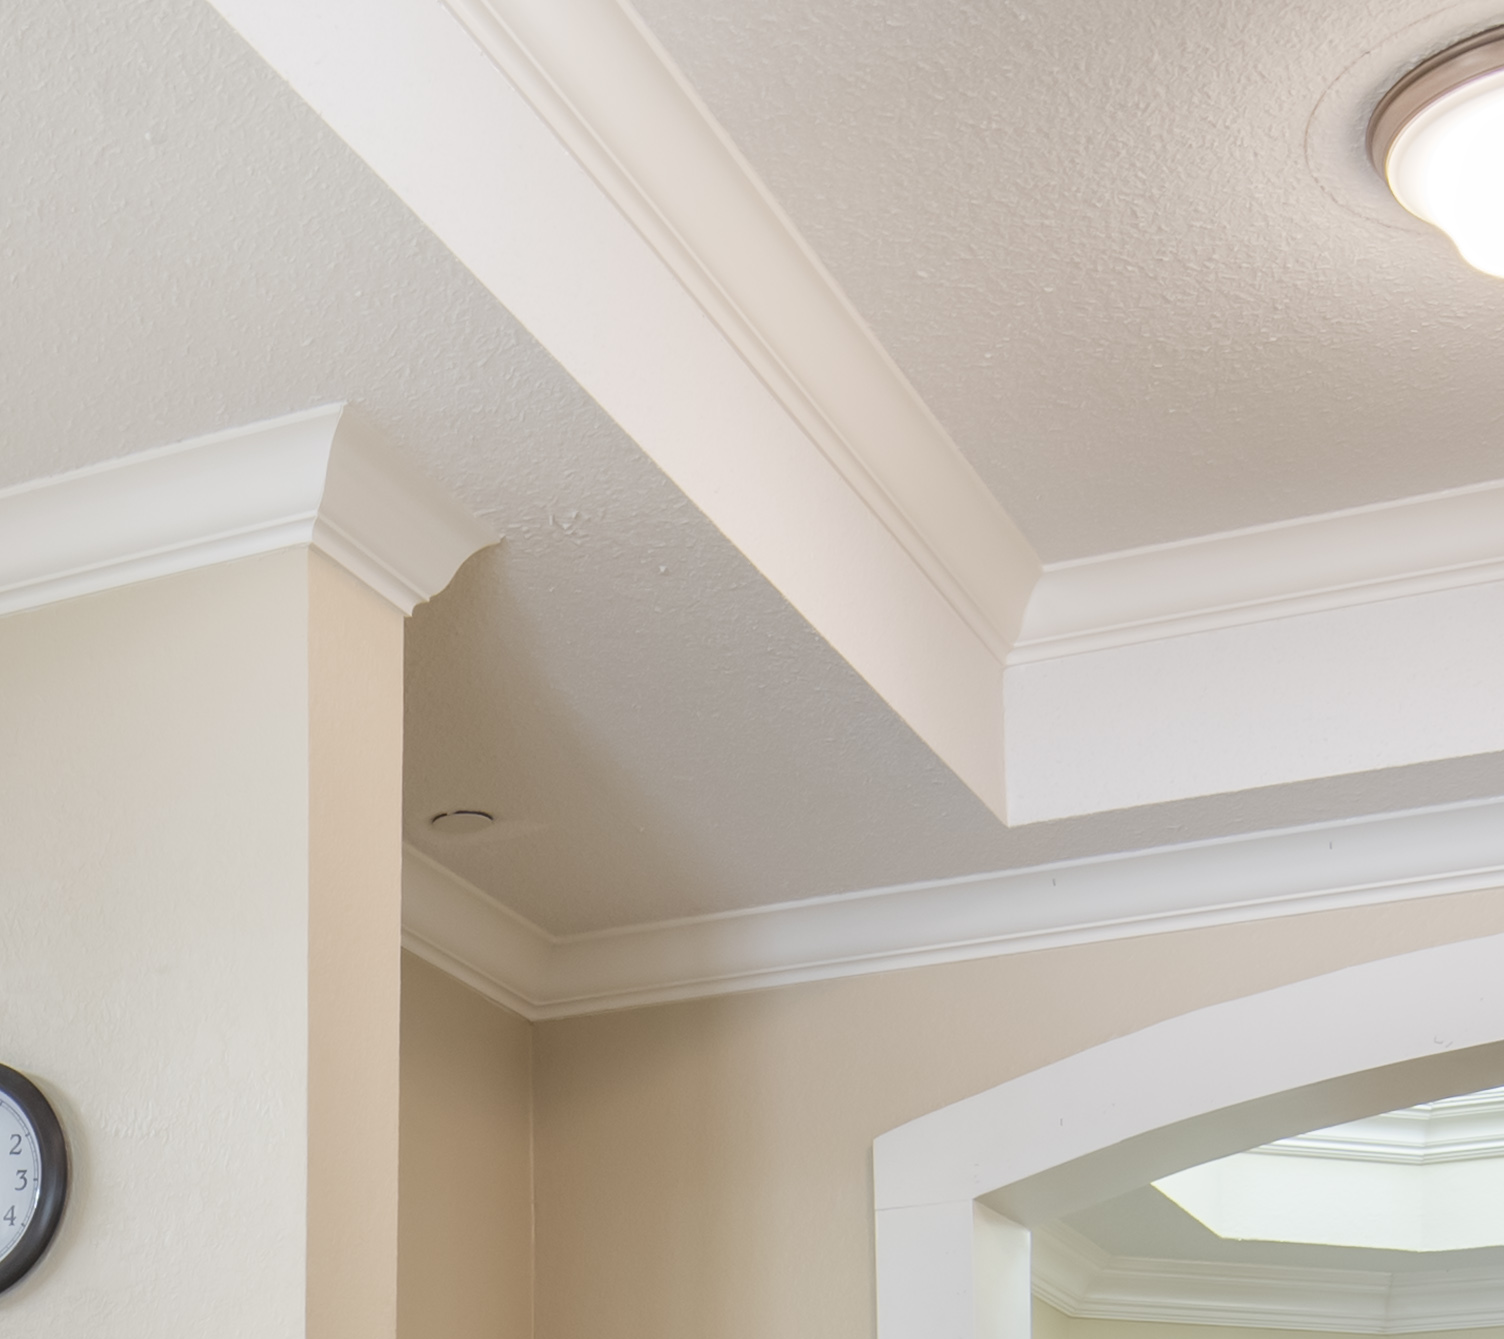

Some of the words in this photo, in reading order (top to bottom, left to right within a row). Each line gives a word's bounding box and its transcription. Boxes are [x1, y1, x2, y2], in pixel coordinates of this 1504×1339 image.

[9, 1134, 23, 1156] 2
[15, 1170, 28, 1191] 3
[3, 1206, 17, 1226] 4
